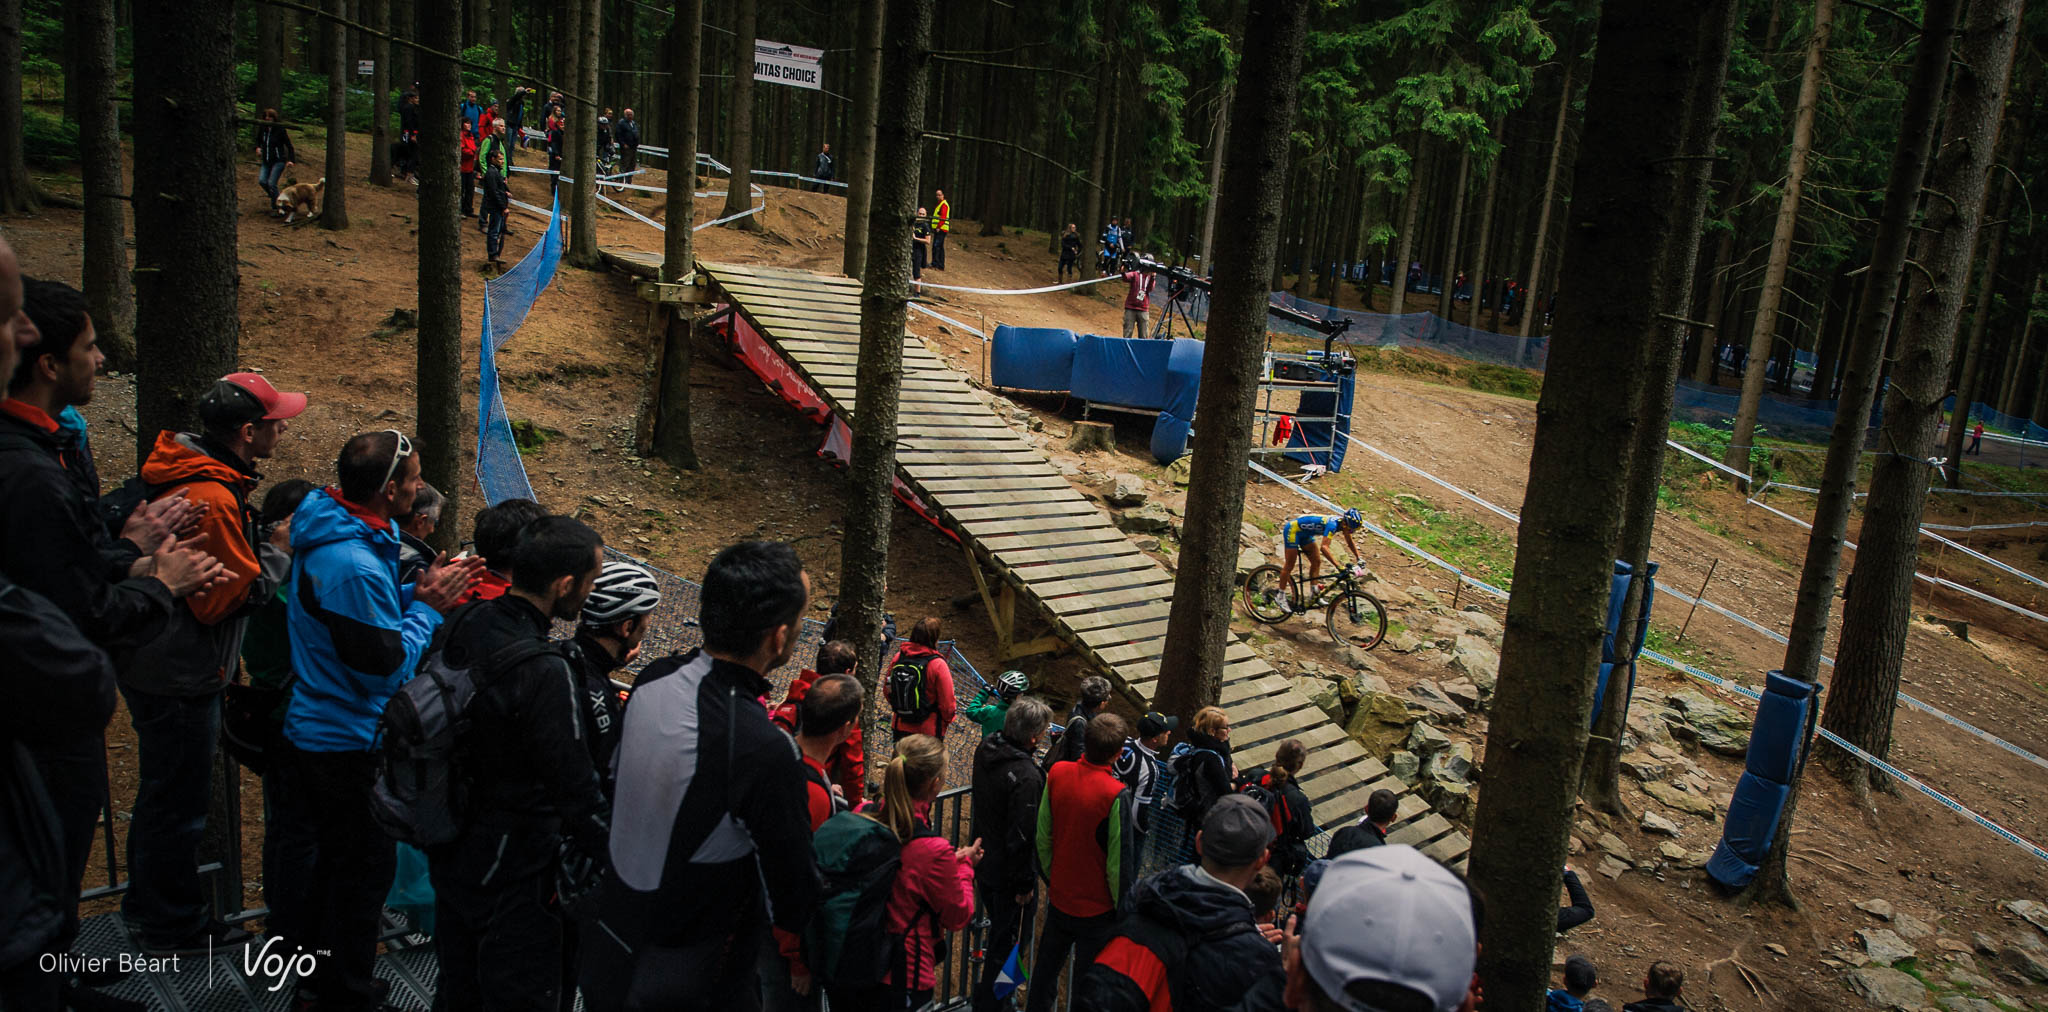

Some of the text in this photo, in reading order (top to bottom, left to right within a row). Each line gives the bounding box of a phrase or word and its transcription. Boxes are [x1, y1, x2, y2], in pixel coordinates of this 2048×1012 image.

[782, 66, 817, 84] CHOICE
[1641, 648, 1762, 699] HIMANO SHIMANO SHIMA
[1822, 729, 2020, 844] SHIMANO SHIMANO SHIMANO SHIMANO
